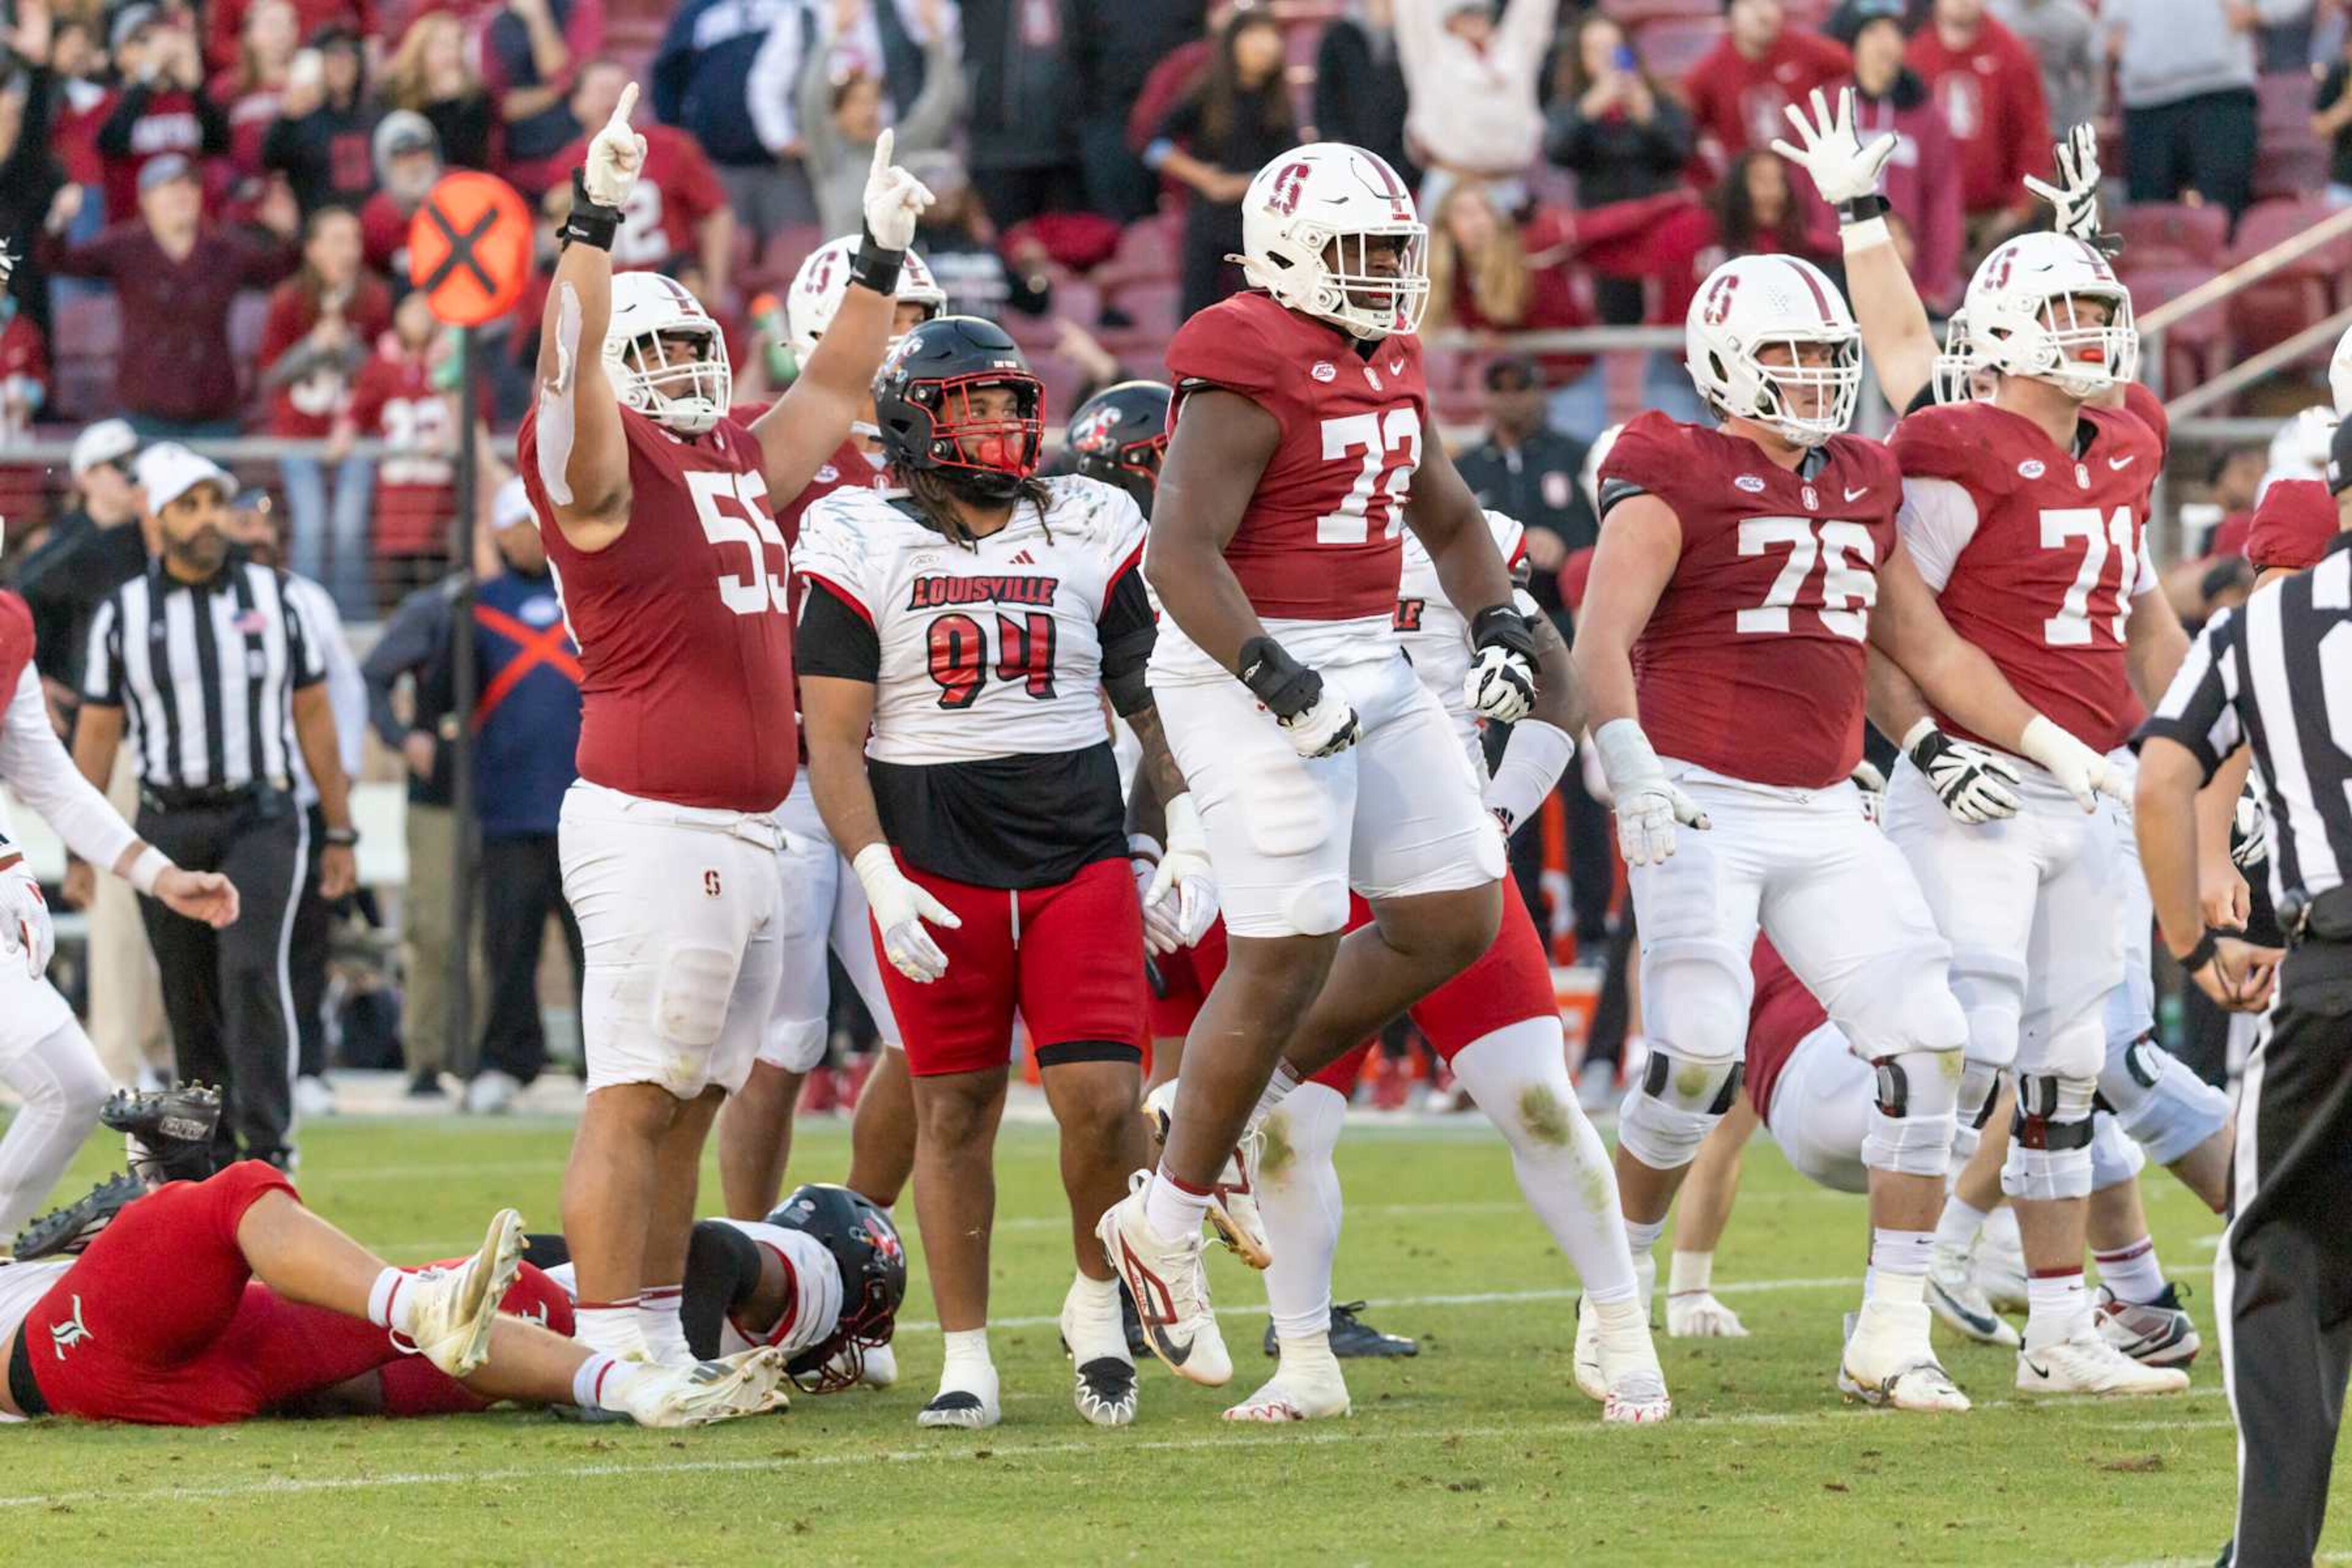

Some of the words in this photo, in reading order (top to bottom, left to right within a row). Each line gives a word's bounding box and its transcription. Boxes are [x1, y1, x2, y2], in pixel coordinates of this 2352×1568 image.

[1316, 407, 1422, 544] 72
[682, 469, 790, 616] 55
[906, 575, 1059, 611] LOUISVILLE
[1736, 516, 1878, 644] 76
[2038, 505, 2138, 645] 71
[926, 612, 1058, 710] 94
